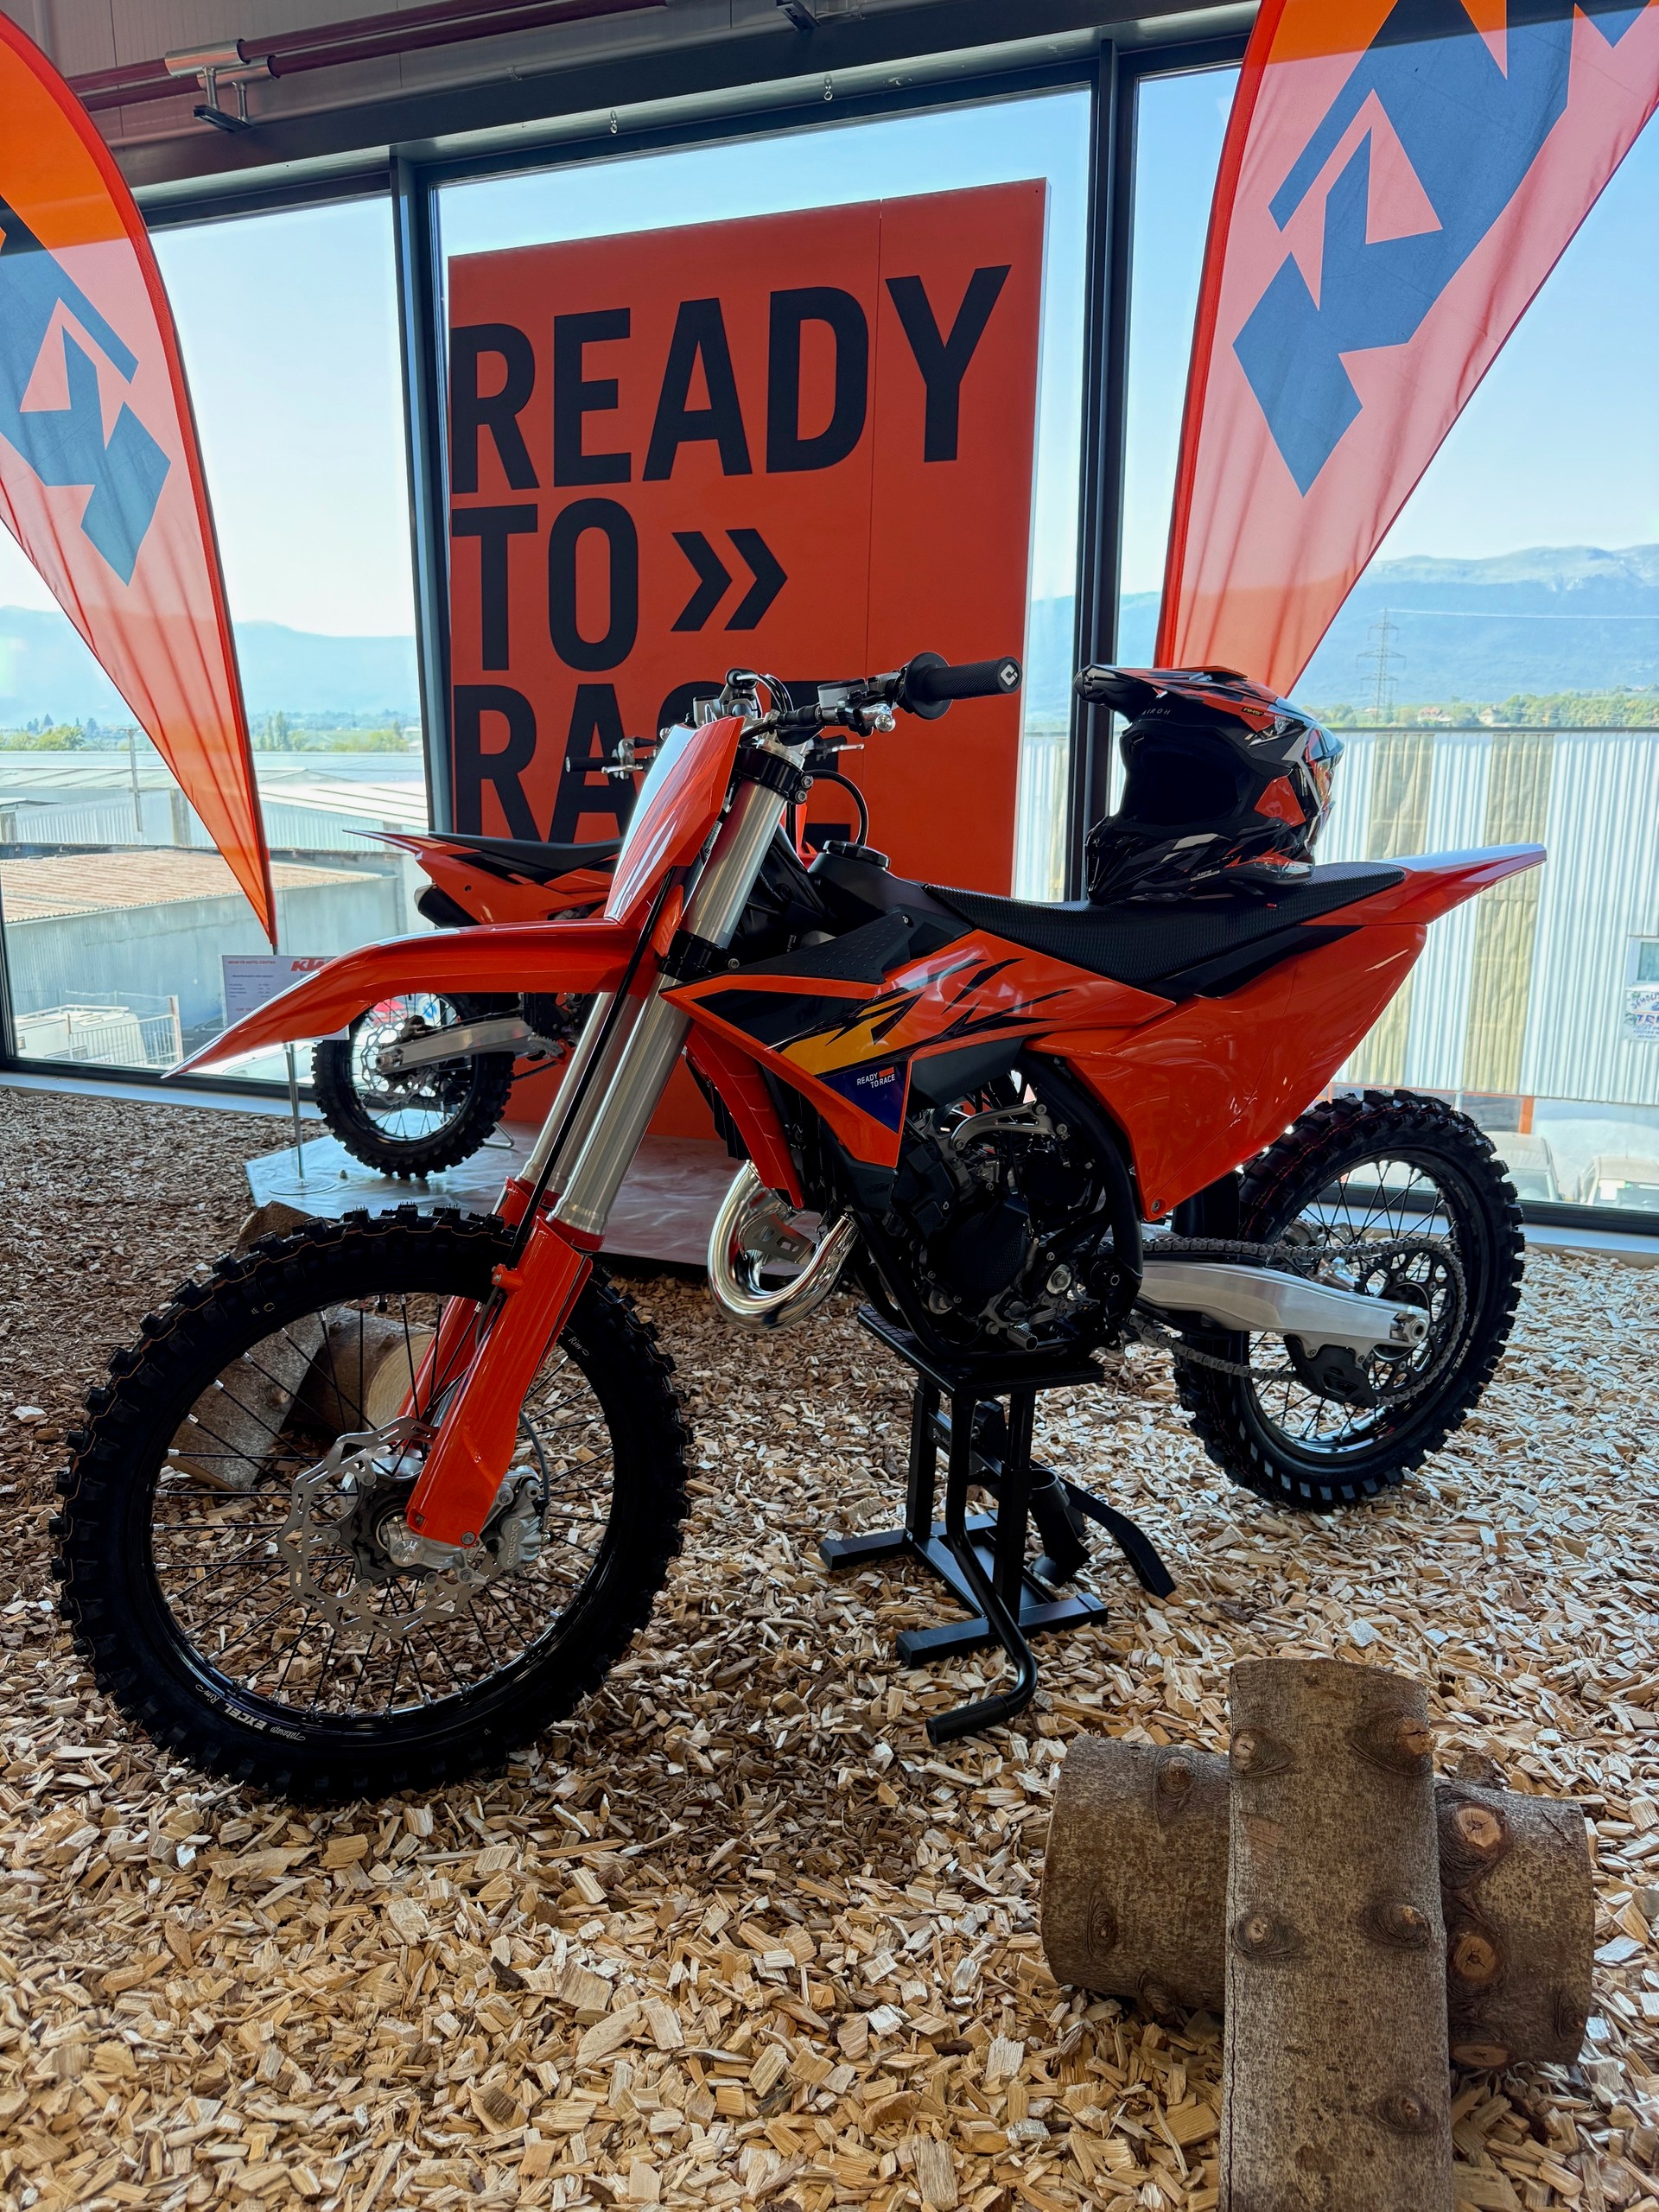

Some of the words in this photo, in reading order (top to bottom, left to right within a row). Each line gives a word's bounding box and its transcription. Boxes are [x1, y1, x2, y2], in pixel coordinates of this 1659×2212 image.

[450, 264, 1012, 494] READY
[451, 498, 638, 672] TO
[856, 1072, 878, 1086] READY
[870, 1080, 879, 1089] TO
[879, 1073, 896, 1086] RACE
[568, 1336, 589, 1357] Rim
[506, 1524, 522, 1566] brembo
[195, 1684, 220, 1705] Rim
[224, 1702, 268, 1731] EXCEL
[270, 1726, 306, 1741] Takasago
